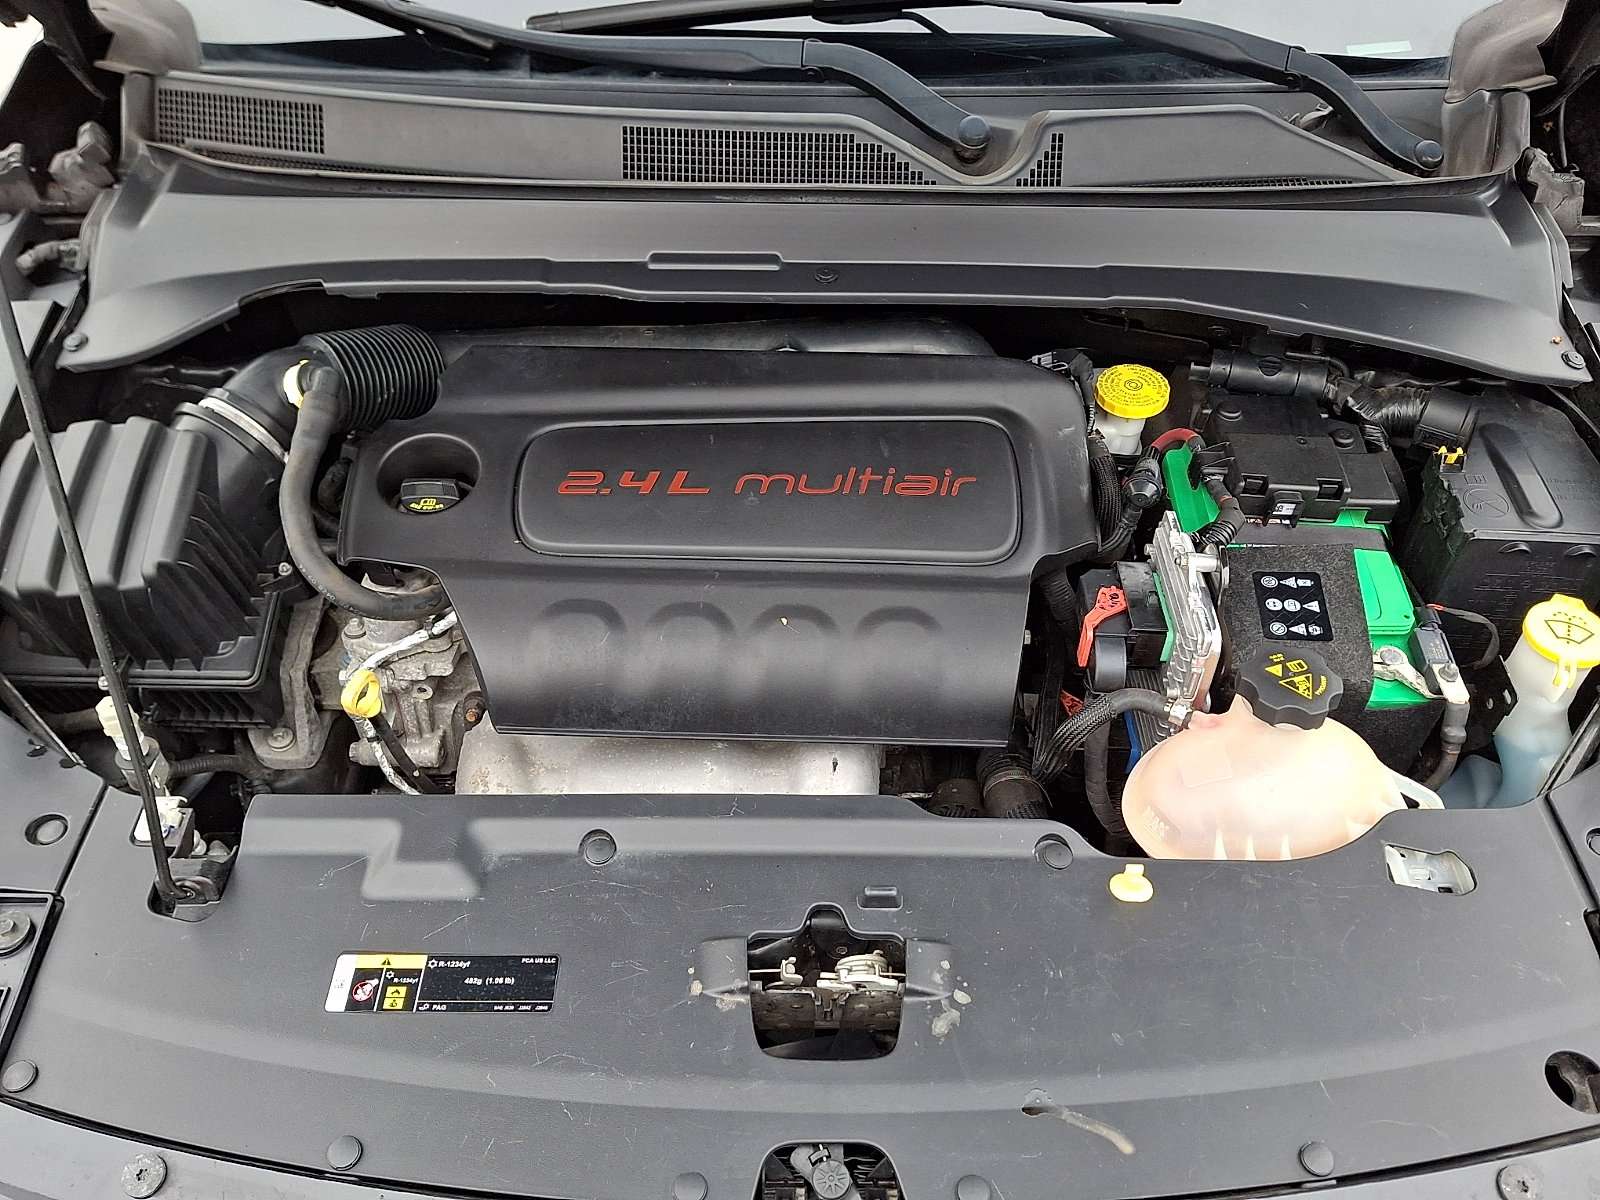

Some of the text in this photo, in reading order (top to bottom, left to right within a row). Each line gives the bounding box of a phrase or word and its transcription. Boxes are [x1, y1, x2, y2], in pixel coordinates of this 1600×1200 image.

[733, 466, 977, 497] multiair
[438, 960, 471, 970] R-1234yf
[393, 977, 419, 985] R-1234yf
